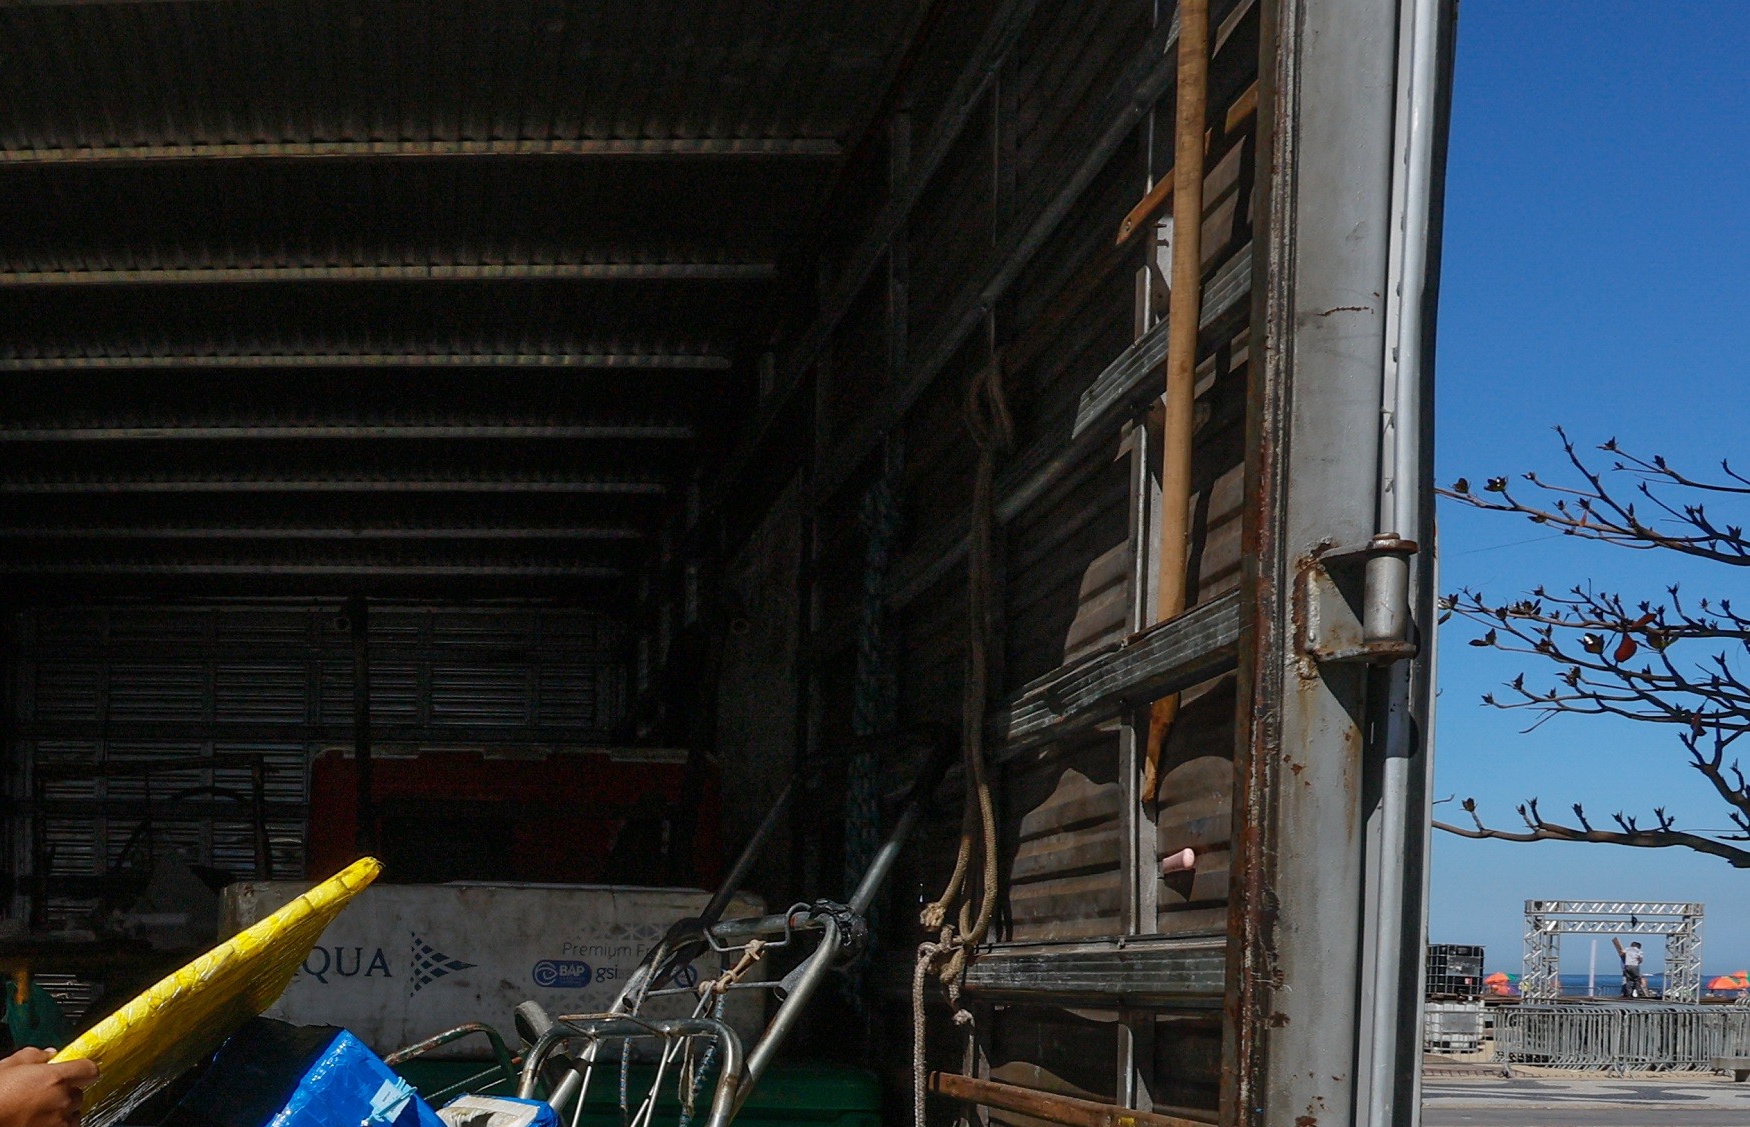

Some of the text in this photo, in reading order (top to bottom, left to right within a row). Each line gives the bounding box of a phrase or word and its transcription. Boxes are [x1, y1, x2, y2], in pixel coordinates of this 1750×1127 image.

[562, 942, 632, 961] Premium
[294, 945, 392, 984] QUA
[559, 965, 585, 977] BAP
